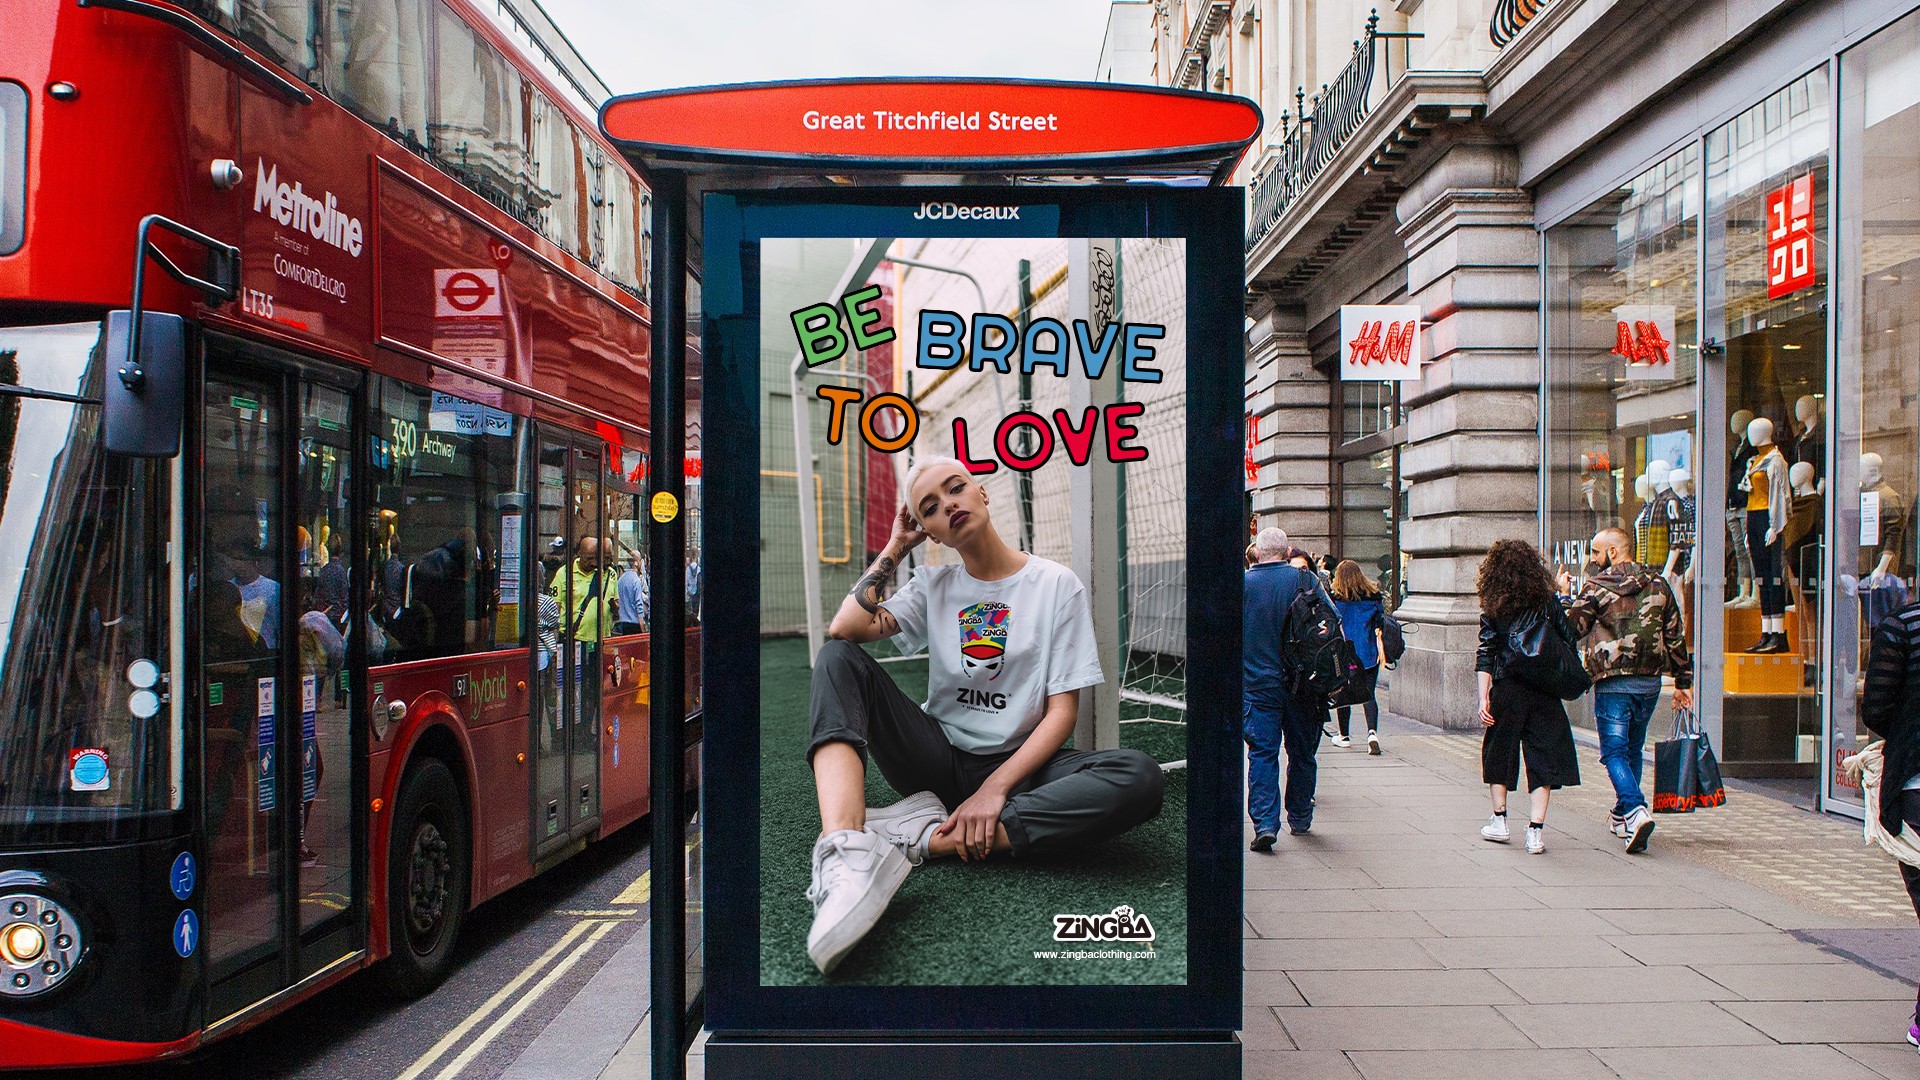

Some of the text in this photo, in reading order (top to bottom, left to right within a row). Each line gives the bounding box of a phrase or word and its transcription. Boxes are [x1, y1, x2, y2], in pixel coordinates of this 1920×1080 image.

[803, 110, 1058, 130] Great Titchfield Street
[254, 156, 363, 258] Metroline
[913, 202, 1020, 220] JCDecaux
[243, 287, 275, 319] LT35
[790, 284, 1166, 384] BE BRAVE
[1349, 320, 1416, 366] H&M
[390, 417, 457, 464] 390 Archway
[816, 384, 1149, 475] TO LOVE
[1563, 540, 1587, 565] NEW
[469, 665, 508, 720] hybrid
[957, 687, 1007, 710] ZING
[73, 748, 109, 761] WARNING
[1033, 950, 1156, 960] www.zingbaclothing.com
